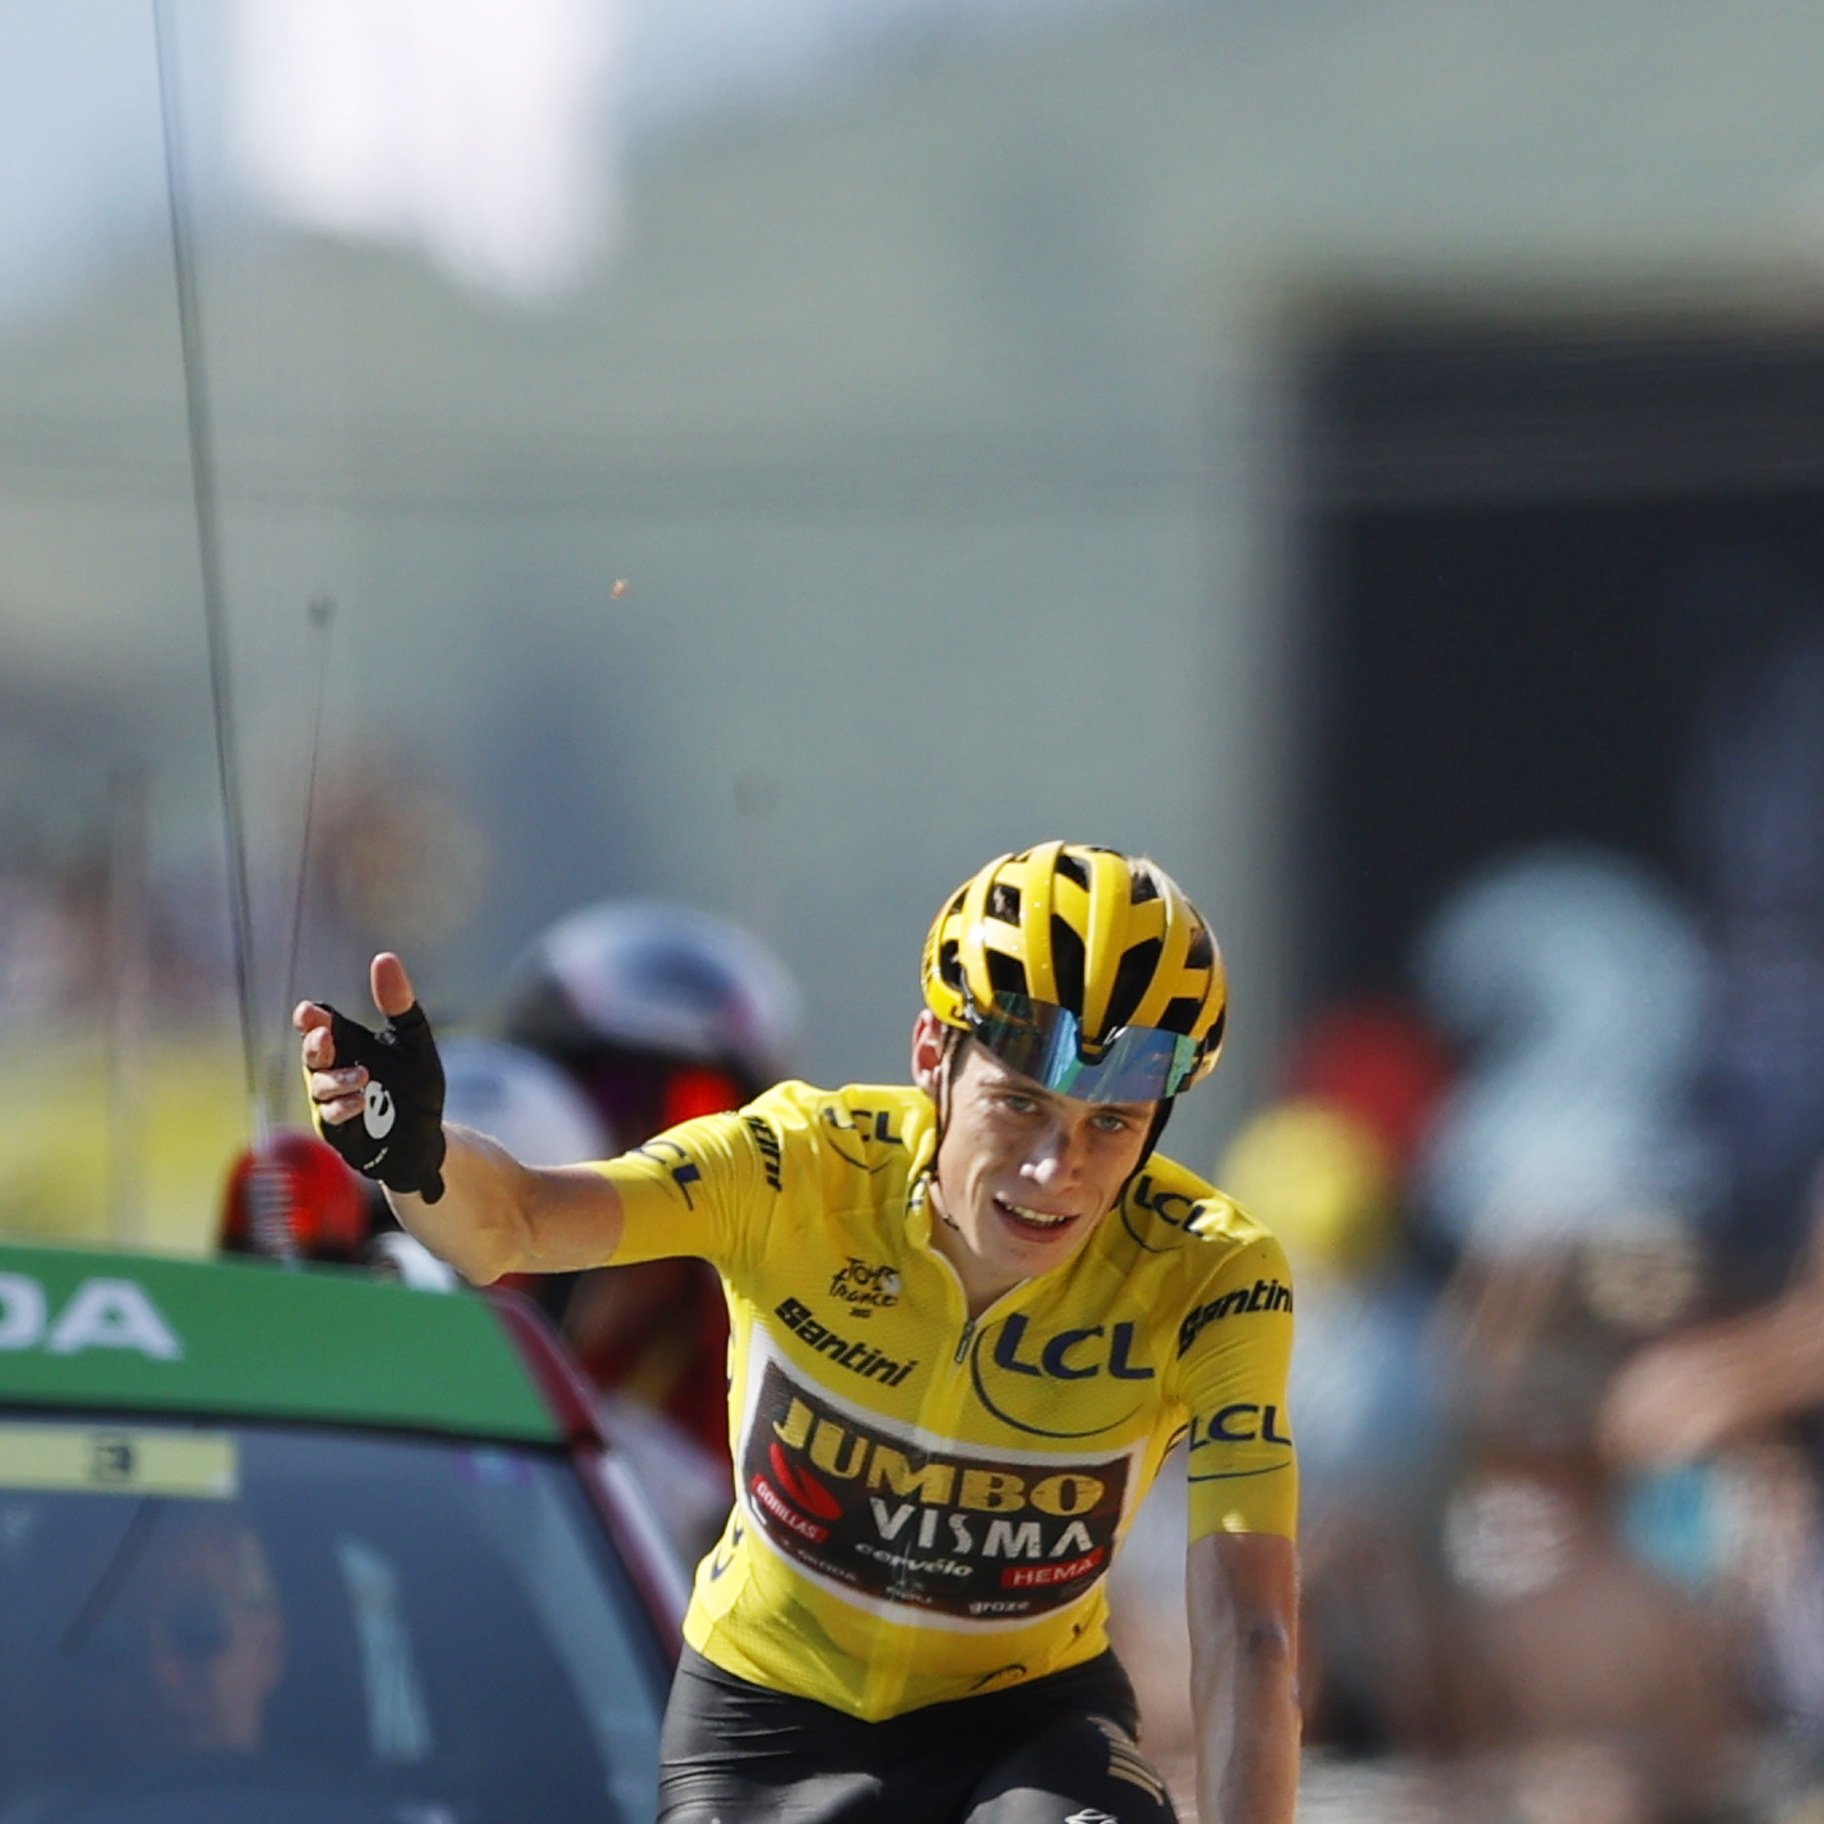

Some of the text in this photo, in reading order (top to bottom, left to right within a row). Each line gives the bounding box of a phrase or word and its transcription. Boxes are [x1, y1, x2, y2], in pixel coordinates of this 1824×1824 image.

[776, 1297, 919, 1387] Santini
[991, 1312, 1154, 1380] LCL
[1177, 1279, 1292, 1360] Santin
[773, 1398, 1105, 1517] JUMBO
[1188, 1404, 1292, 1452] LCL
[755, 1480, 821, 1541] GORILLAS
[869, 1497, 1094, 1559] VISMA
[1013, 1558, 1096, 1586] HEMA
